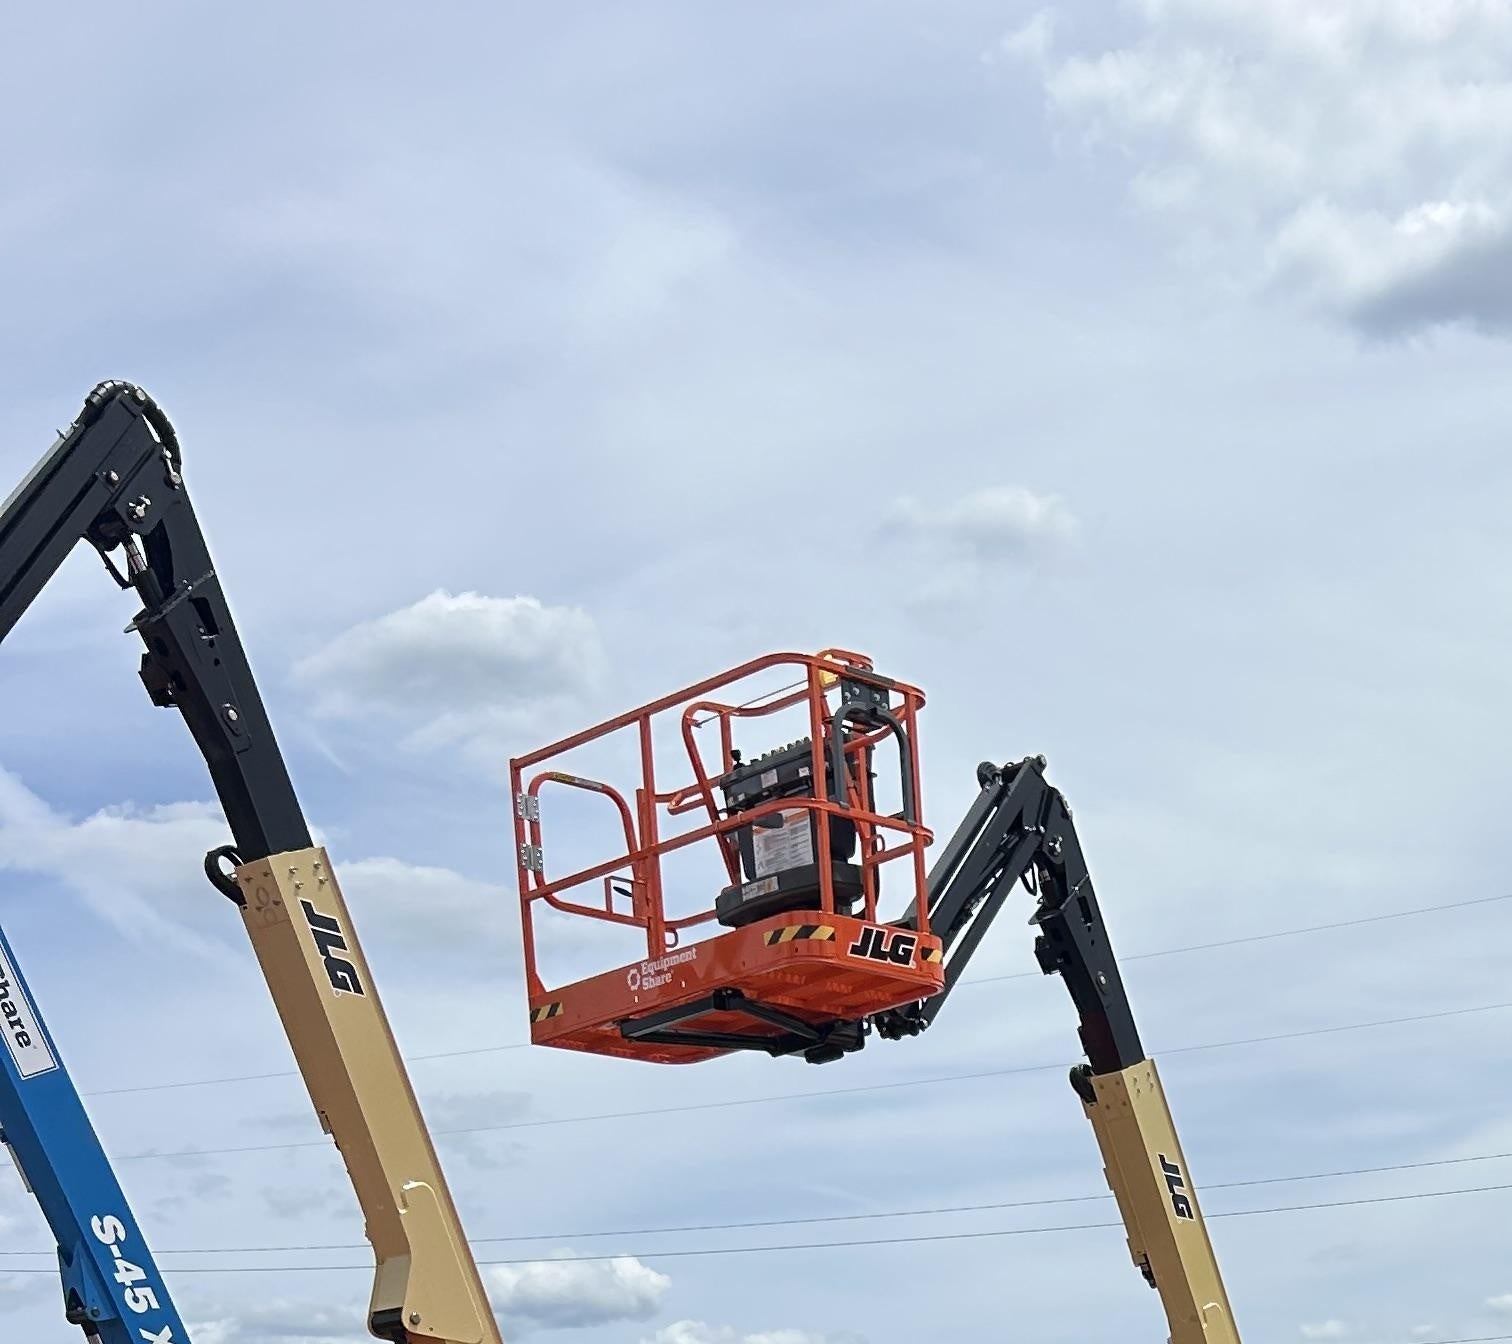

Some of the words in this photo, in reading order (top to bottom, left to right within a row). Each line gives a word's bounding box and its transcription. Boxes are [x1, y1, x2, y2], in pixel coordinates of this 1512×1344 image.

[301, 898, 364, 998] JLG
[641, 947, 697, 974] Equipment
[849, 926, 917, 970] JLG
[642, 970, 672, 991] Share
[1158, 1153, 1194, 1221] JLG
[91, 1214, 159, 1315] S-45
